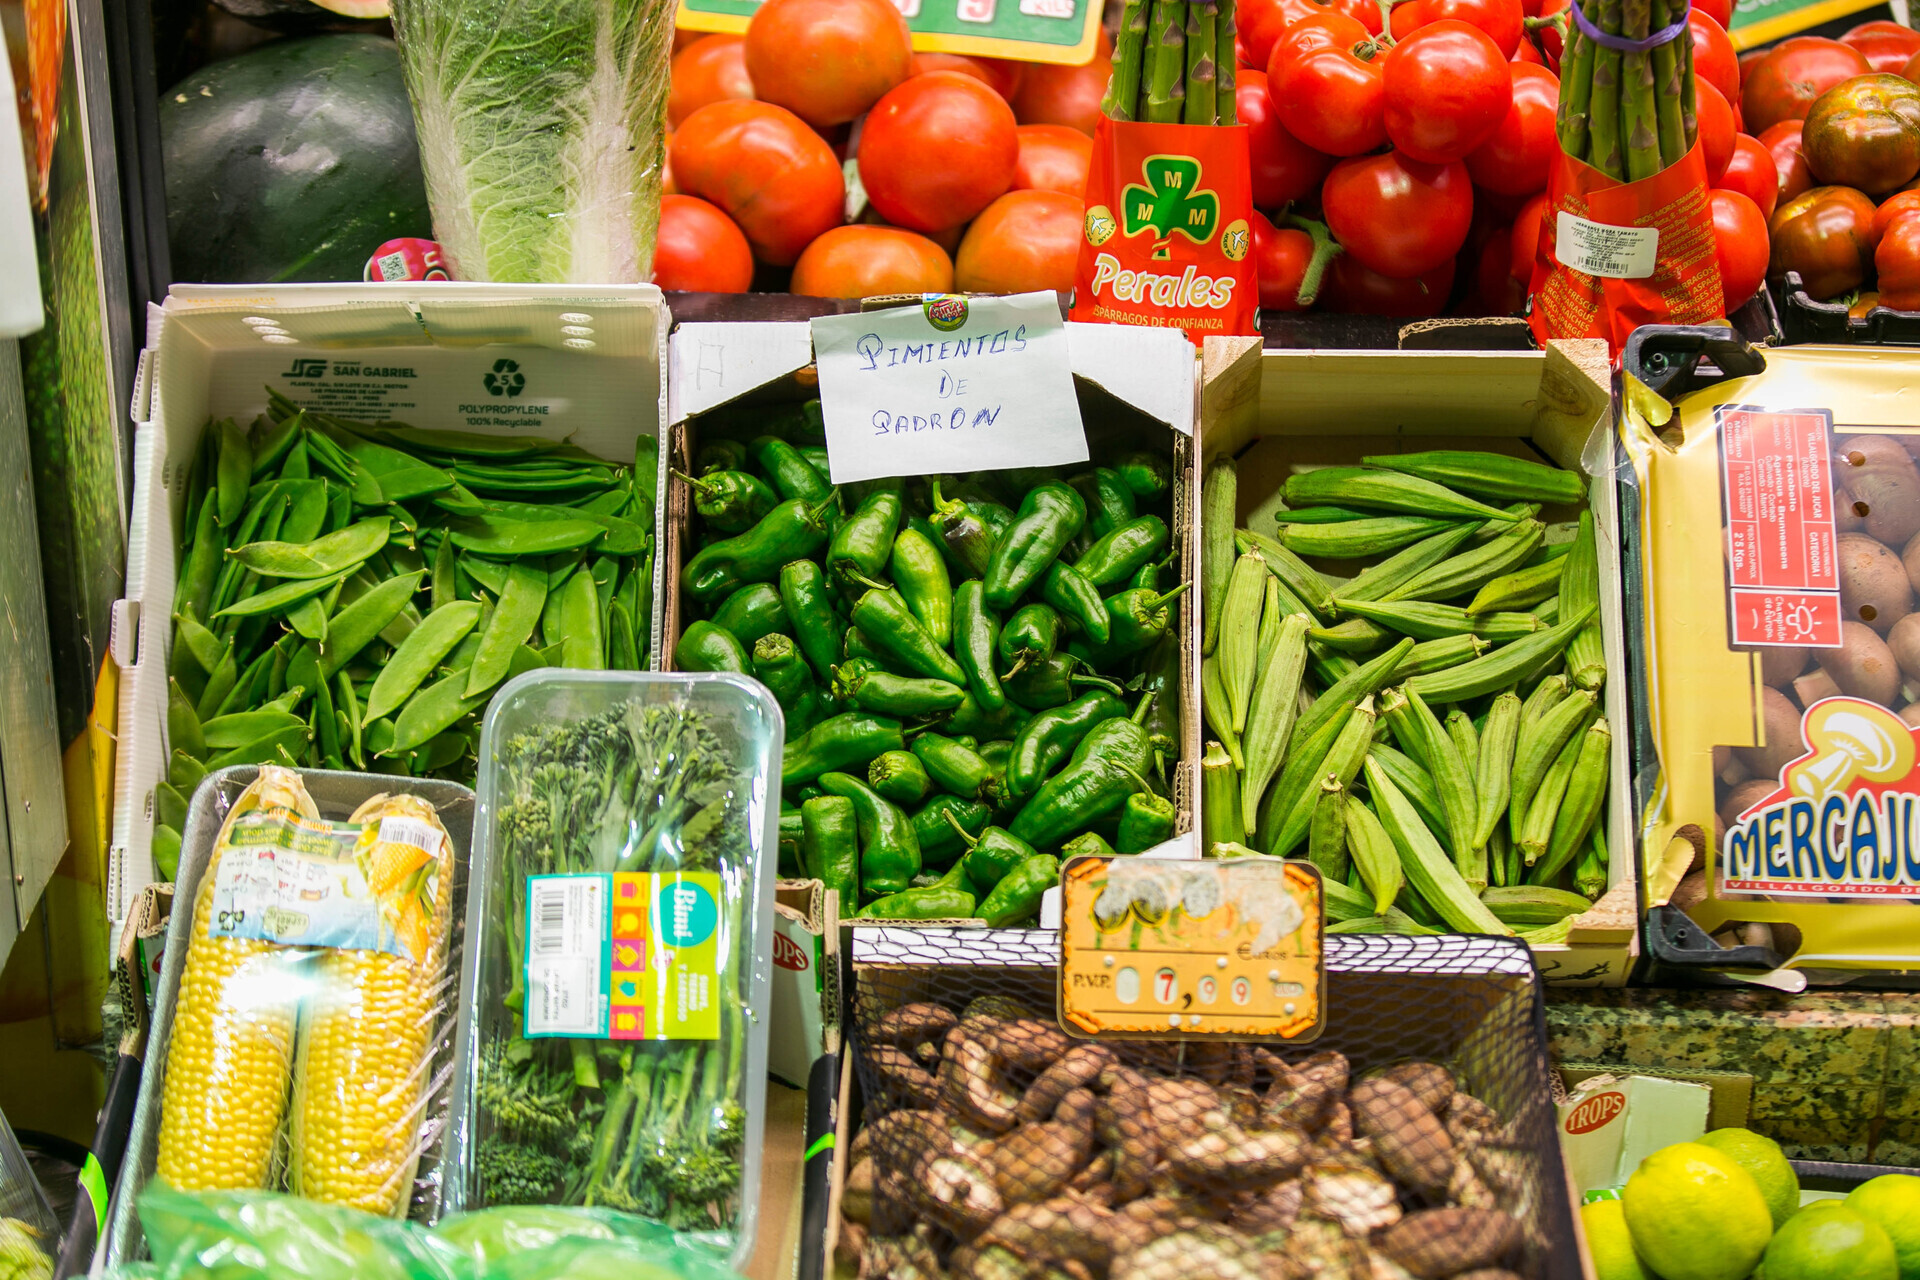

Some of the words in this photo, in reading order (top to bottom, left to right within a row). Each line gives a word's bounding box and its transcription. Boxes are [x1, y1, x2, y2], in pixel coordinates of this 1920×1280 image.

[1164, 171, 1182, 189] M
[1137, 203, 1154, 221] M
[1189, 208, 1207, 225] M
[1091, 252, 1236, 309] Perales
[1565, 287, 1601, 315] FRESCOS
[1663, 289, 1692, 309] FRESH
[1667, 290, 1710, 318] ASPERGES
[1151, 316, 1165, 328] DE
[1168, 317, 1223, 330] CONFIANZA
[1670, 304, 1701, 325] FRISCH
[333, 366, 359, 377] SAN
[362, 367, 418, 378] GABRIEL
[501, 375, 509, 385] 5
[938, 369, 968, 398] DE
[459, 405, 549, 415] POLYPROPYLENE
[466, 418, 490, 426] 100%
[493, 418, 541, 428] Recyclable
[1726, 422, 1735, 455] Grueso
[1734, 420, 1743, 458] Mediano
[1807, 432, 1820, 479] VILLALGORDO
[1757, 458, 1766, 487] Cerrado
[1765, 455, 1775, 488] Cultivado
[1774, 455, 1784, 497] Agaricus
[1786, 455, 1797, 512] Portobello
[1811, 481, 1820, 493] DEL
[1767, 493, 1777, 522] Cortado
[1778, 505, 1789, 569] Brunnescens
[1809, 532, 1820, 572] CATEGORIA
[1730, 881, 1887, 893] VILLALGORDO
[673, 888, 697, 938] Bimi
[774, 933, 806, 969] OPS
[1073, 973, 1111, 989] P.V.P.
[677, 972, 688, 1023] SABROSO
[1569, 1096, 1622, 1131] TROPS
